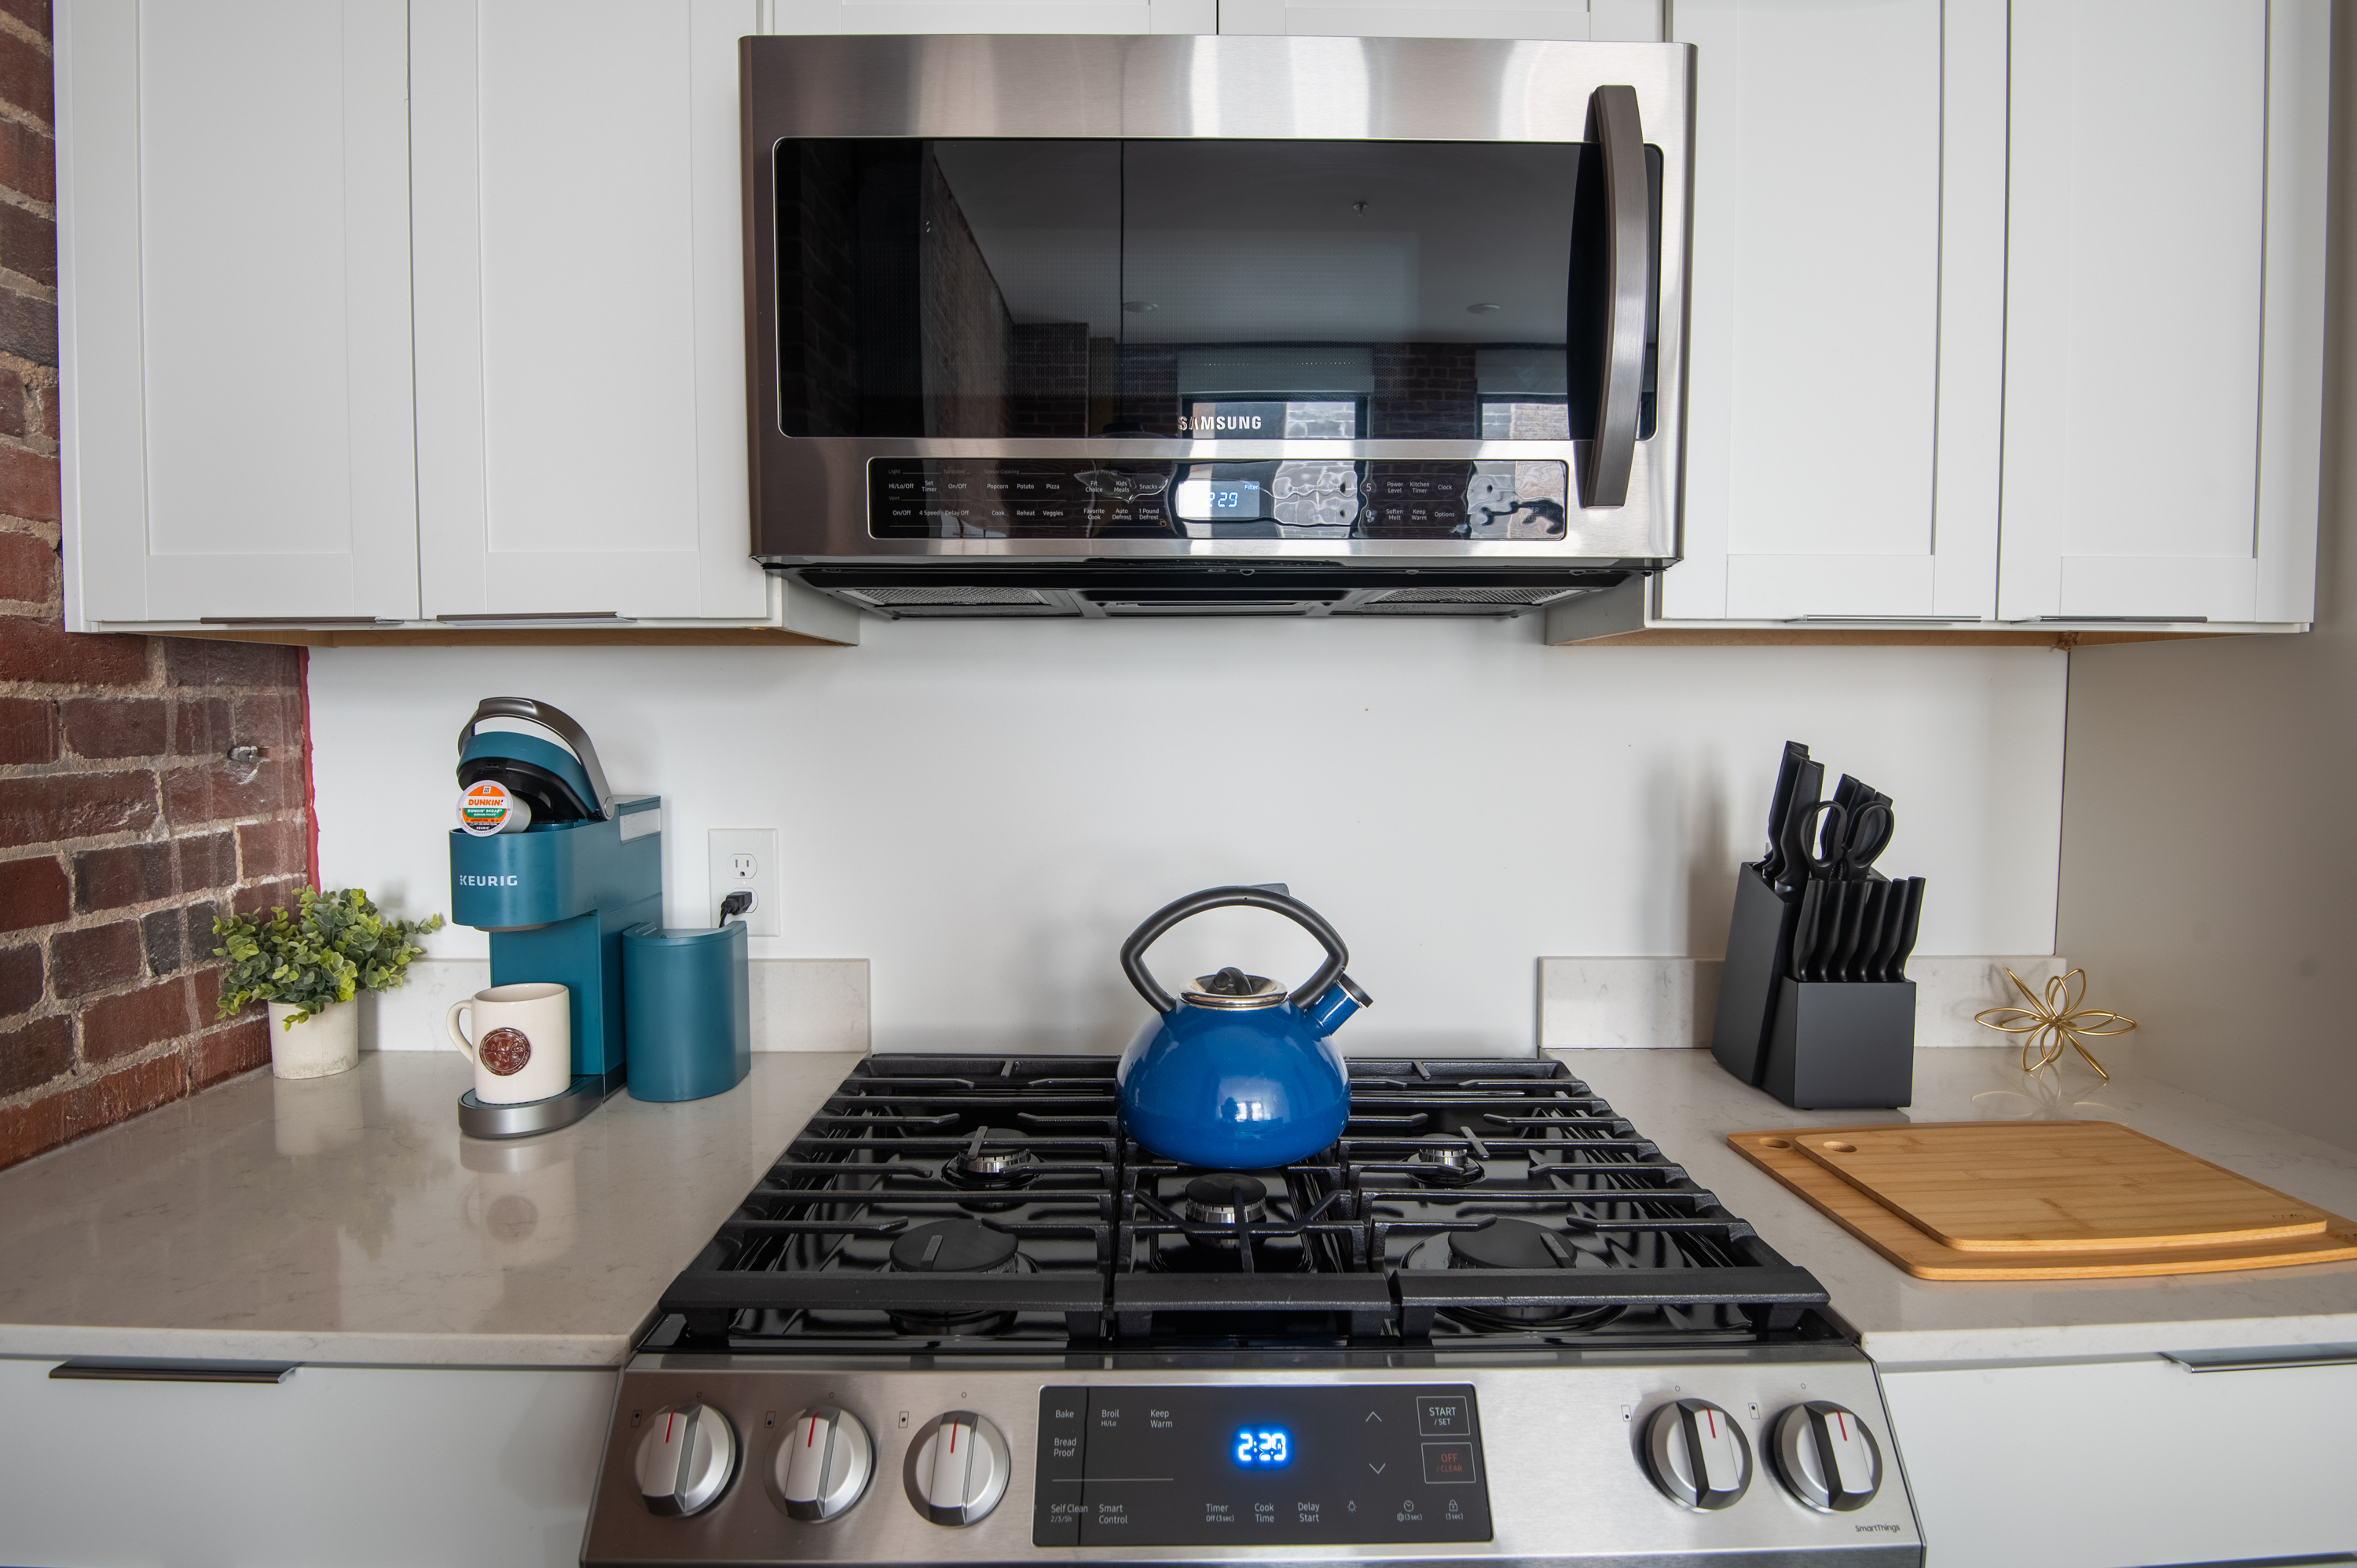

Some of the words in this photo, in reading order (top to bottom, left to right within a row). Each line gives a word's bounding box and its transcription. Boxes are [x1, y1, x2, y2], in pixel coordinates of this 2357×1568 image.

[1178, 416, 1261, 430] SAMSUNG
[1366, 483, 1372, 492] 5
[460, 874, 518, 886] KEURIG
[1055, 1409, 1074, 1418] Bake
[1102, 1409, 1120, 1418] Broil
[1150, 1409, 1169, 1419] Keep
[1428, 1407, 1456, 1416] START
[1150, 1420, 1172, 1428] Warm
[1054, 1438, 1076, 1446] Bread
[1238, 1433, 1287, 1461] 2:29
[1054, 1449, 1075, 1457] Proof
[1441, 1453, 1458, 1463] OFF
[1051, 1504, 1066, 1513] Self
[1067, 1504, 1088, 1513] Clean
[1099, 1504, 1123, 1513] Smart
[1206, 1504, 1228, 1512] Timer
[1255, 1503, 1274, 1512] Cook
[1298, 1502, 1319, 1512] Delay
[1050, 1515, 1072, 1523] 2/3/5h
[1098, 1515, 1128, 1524] Control
[1255, 1514, 1274, 1522] Time
[1299, 1513, 1319, 1522] Start
[1855, 1523, 1900, 1533] SmartThings
